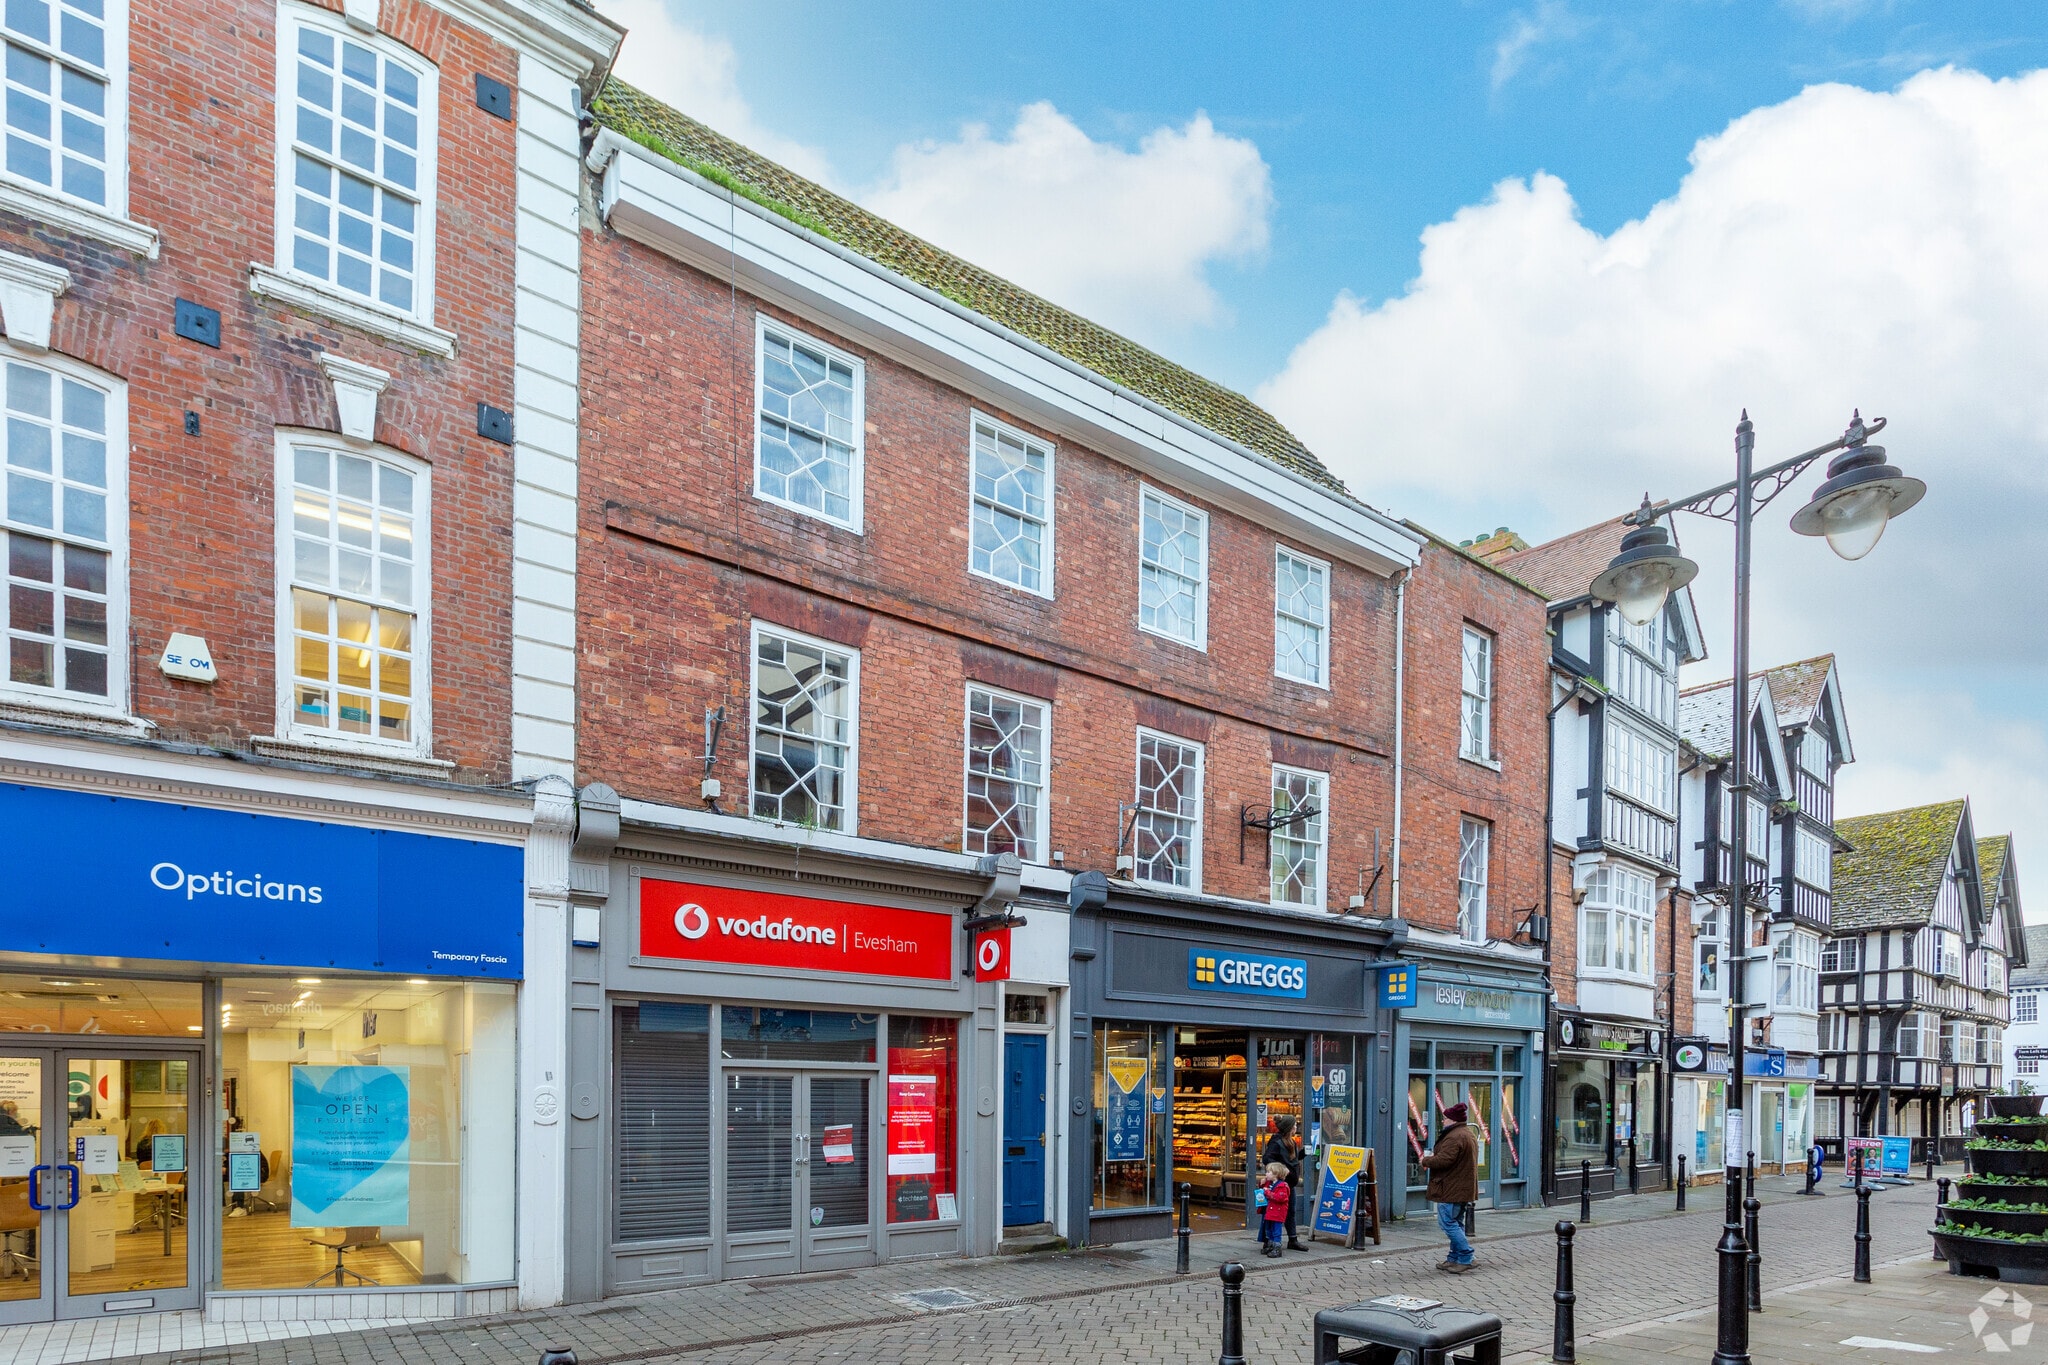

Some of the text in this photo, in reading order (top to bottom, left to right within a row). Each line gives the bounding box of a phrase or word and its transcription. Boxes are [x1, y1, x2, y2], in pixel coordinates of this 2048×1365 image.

[150, 862, 323, 904] Opticians
[717, 915, 917, 953] vodafone Evesham
[432, 950, 508, 964] Temporary Fascia
[1219, 959, 1304, 990] GREGGS
[1329, 1069, 1346, 1085] GO
[325, 1104, 378, 1115] OPEN
[1334, 1150, 1361, 1159] Reduced
[1336, 1158, 1354, 1166] range
